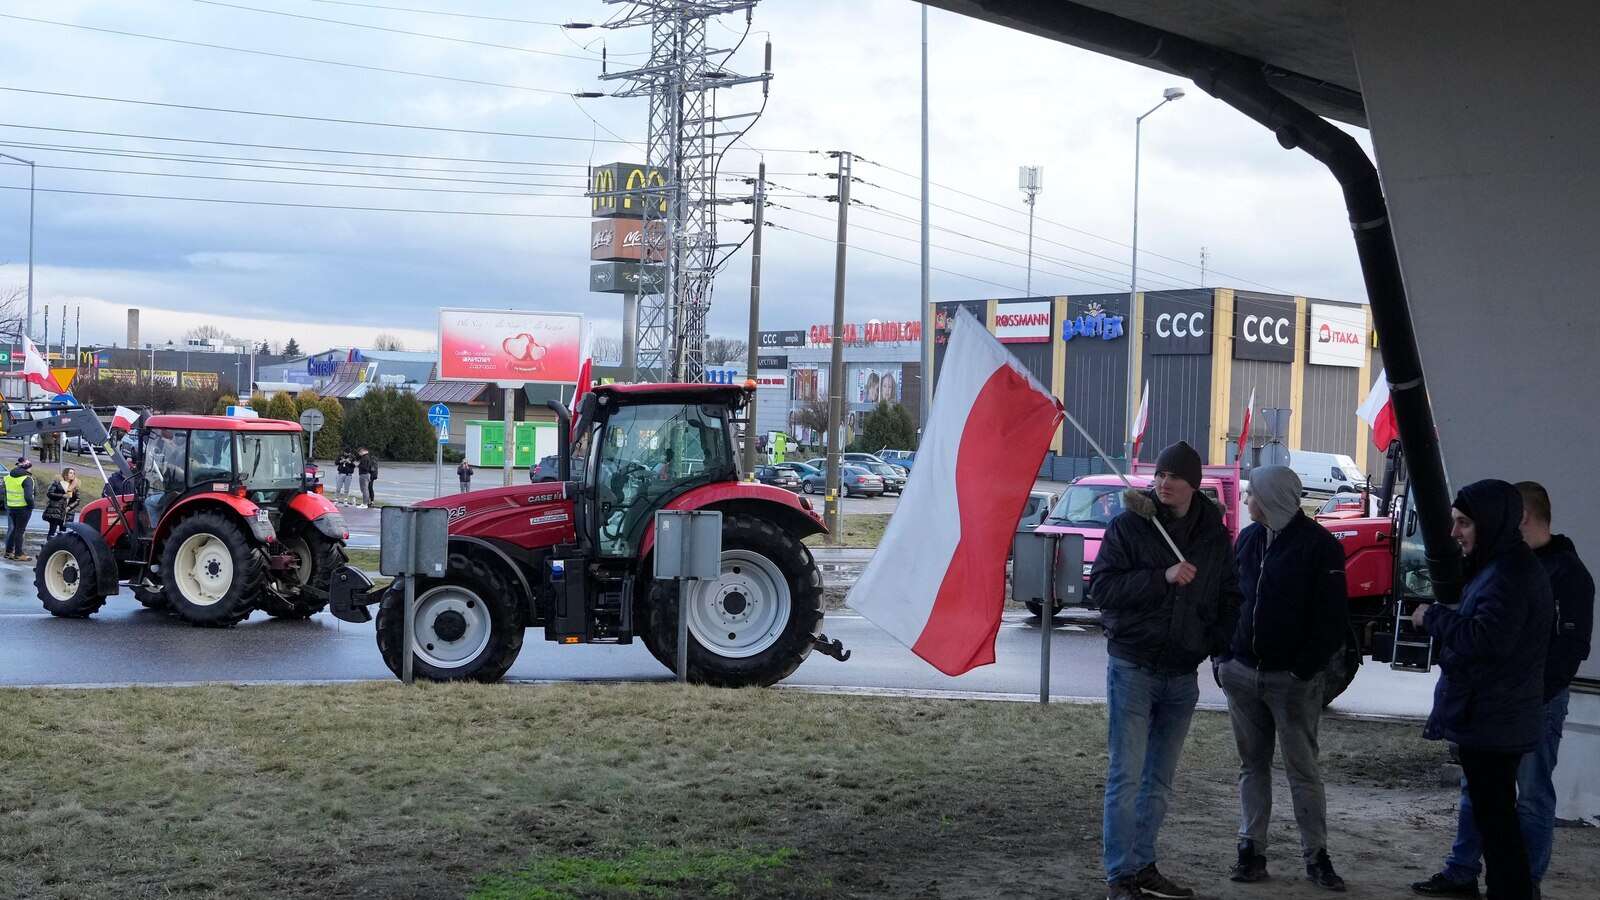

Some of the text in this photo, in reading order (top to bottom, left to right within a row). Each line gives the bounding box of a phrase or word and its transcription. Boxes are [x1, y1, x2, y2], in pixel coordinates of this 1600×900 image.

[995, 314, 1049, 327] ROSSMANN
[1156, 312, 1205, 338] CCC
[1061, 313, 1123, 342] BARTEK
[1243, 314, 1289, 345] CCC
[762, 333, 777, 344] CCC
[785, 333, 799, 344] empik
[1331, 331, 1360, 345] ITAKA
[528, 494, 553, 503] CASE
[449, 506, 466, 519] 25
